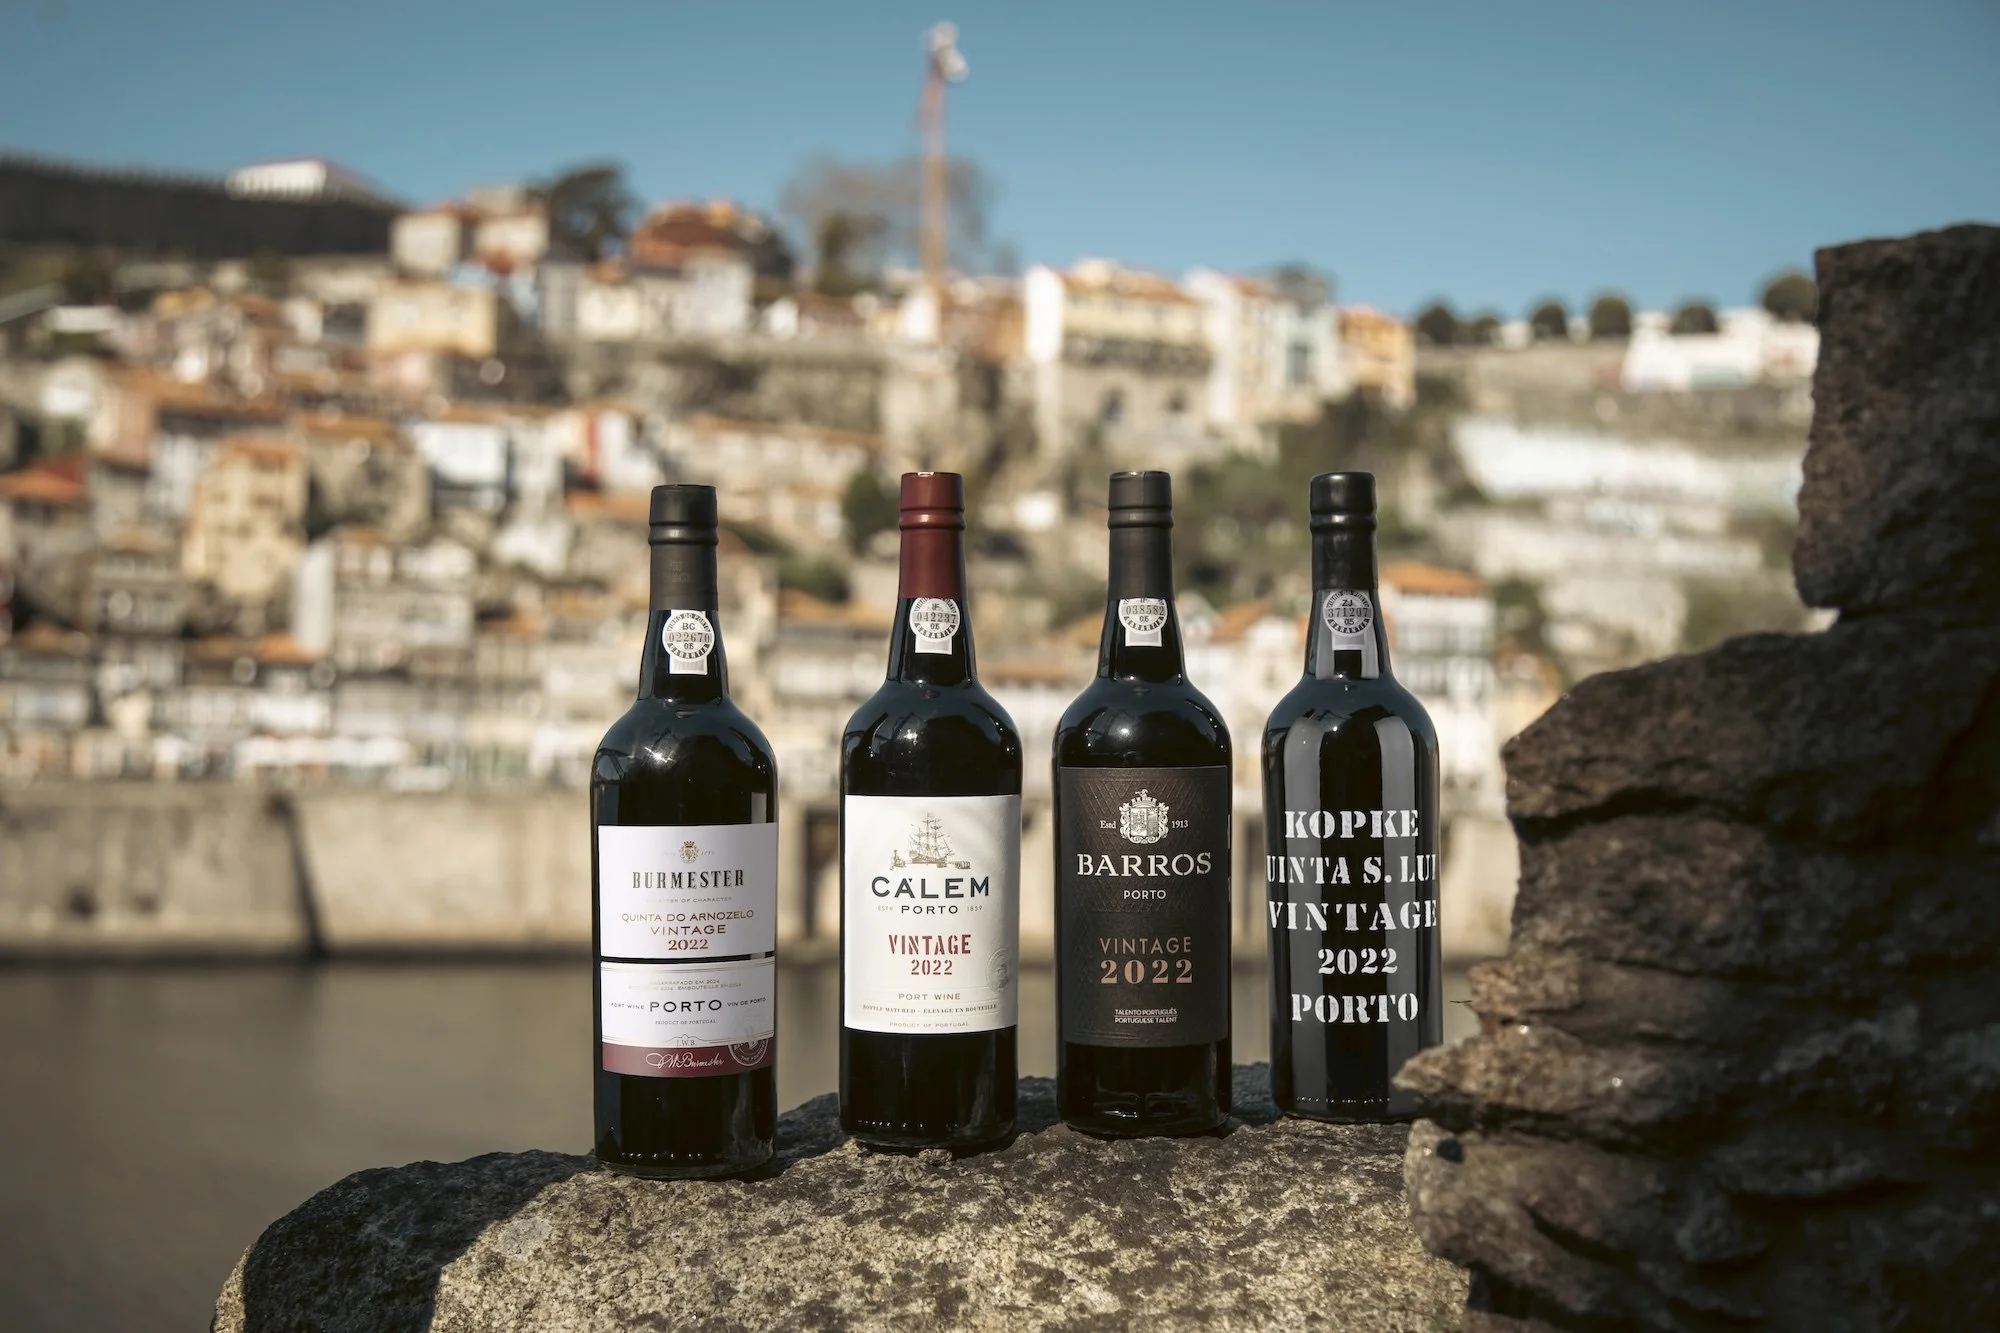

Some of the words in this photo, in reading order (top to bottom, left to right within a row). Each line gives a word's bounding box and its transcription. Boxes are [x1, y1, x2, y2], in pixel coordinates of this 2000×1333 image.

[669, 632, 711, 643] 022670
[1100, 820, 1117, 829] Estd
[1171, 819, 1189, 829] 1913
[1285, 809, 1419, 839] KOPKE
[1077, 852, 1212, 877] BARROS
[1363, 856, 1392, 884] S.
[632, 869, 744, 890] BURMESTER
[1123, 889, 1167, 900] PORTO
[622, 913, 662, 922] QUINTA
[667, 913, 685, 922] DO
[689, 910, 754, 920] ARNOZELO
[901, 905, 959, 915] PORTO
[1268, 899, 1437, 931] VINTAGE
[650, 924, 727, 936] VINTAGE
[668, 939, 709, 950] 2022
[888, 934, 972, 955] VINTAGE
[1100, 936, 1192, 955] VINTAGE
[911, 959, 953, 975] 2022
[1317, 948, 1398, 975] 2022
[1100, 959, 1193, 985] 2022
[650, 1000, 722, 1012] PORTO
[1291, 992, 1419, 1024] PORTO
[1156, 1016, 1178, 1024] TALENT
